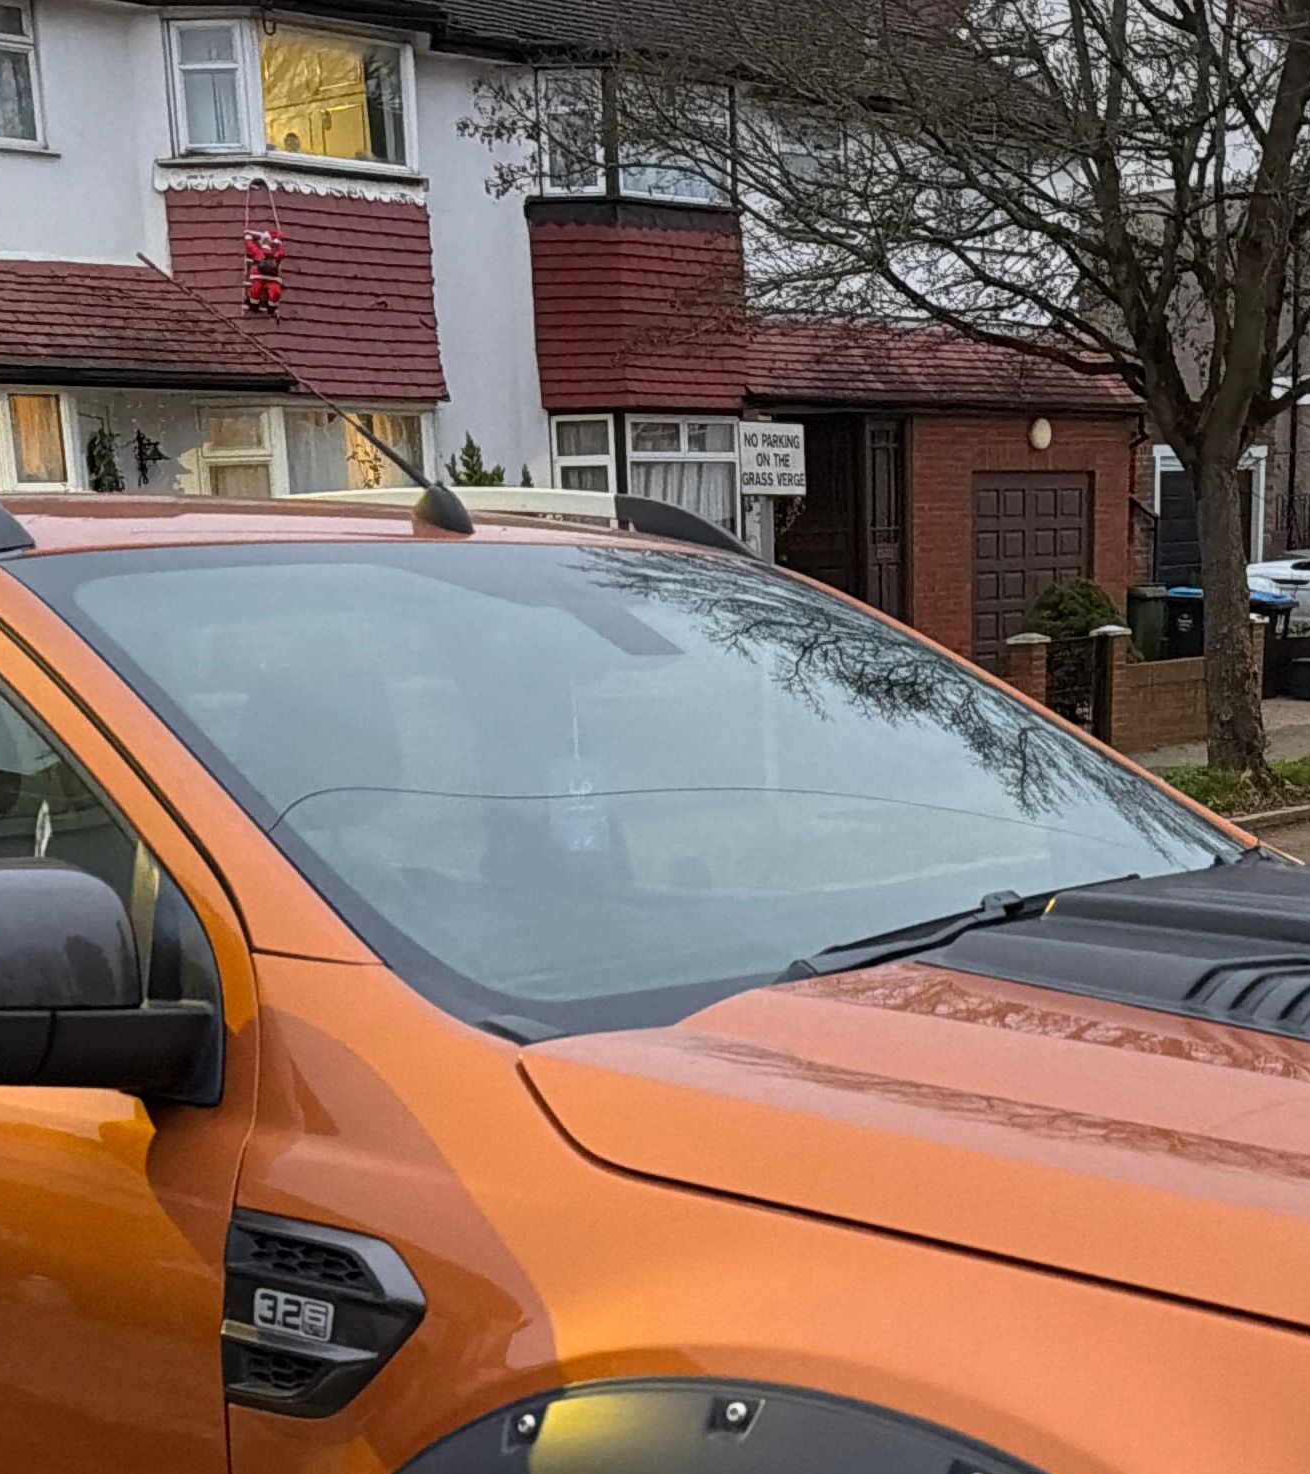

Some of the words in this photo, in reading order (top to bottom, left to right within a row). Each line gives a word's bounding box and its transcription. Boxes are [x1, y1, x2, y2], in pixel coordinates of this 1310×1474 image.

[744, 433, 758, 448] NO
[761, 433, 800, 449] PARKING
[756, 452, 770, 467] ON
[773, 453, 790, 468] THE
[742, 472, 774, 486] GRASS
[777, 472, 805, 487] VERGE
[257, 1292, 302, 1331] 3.2
